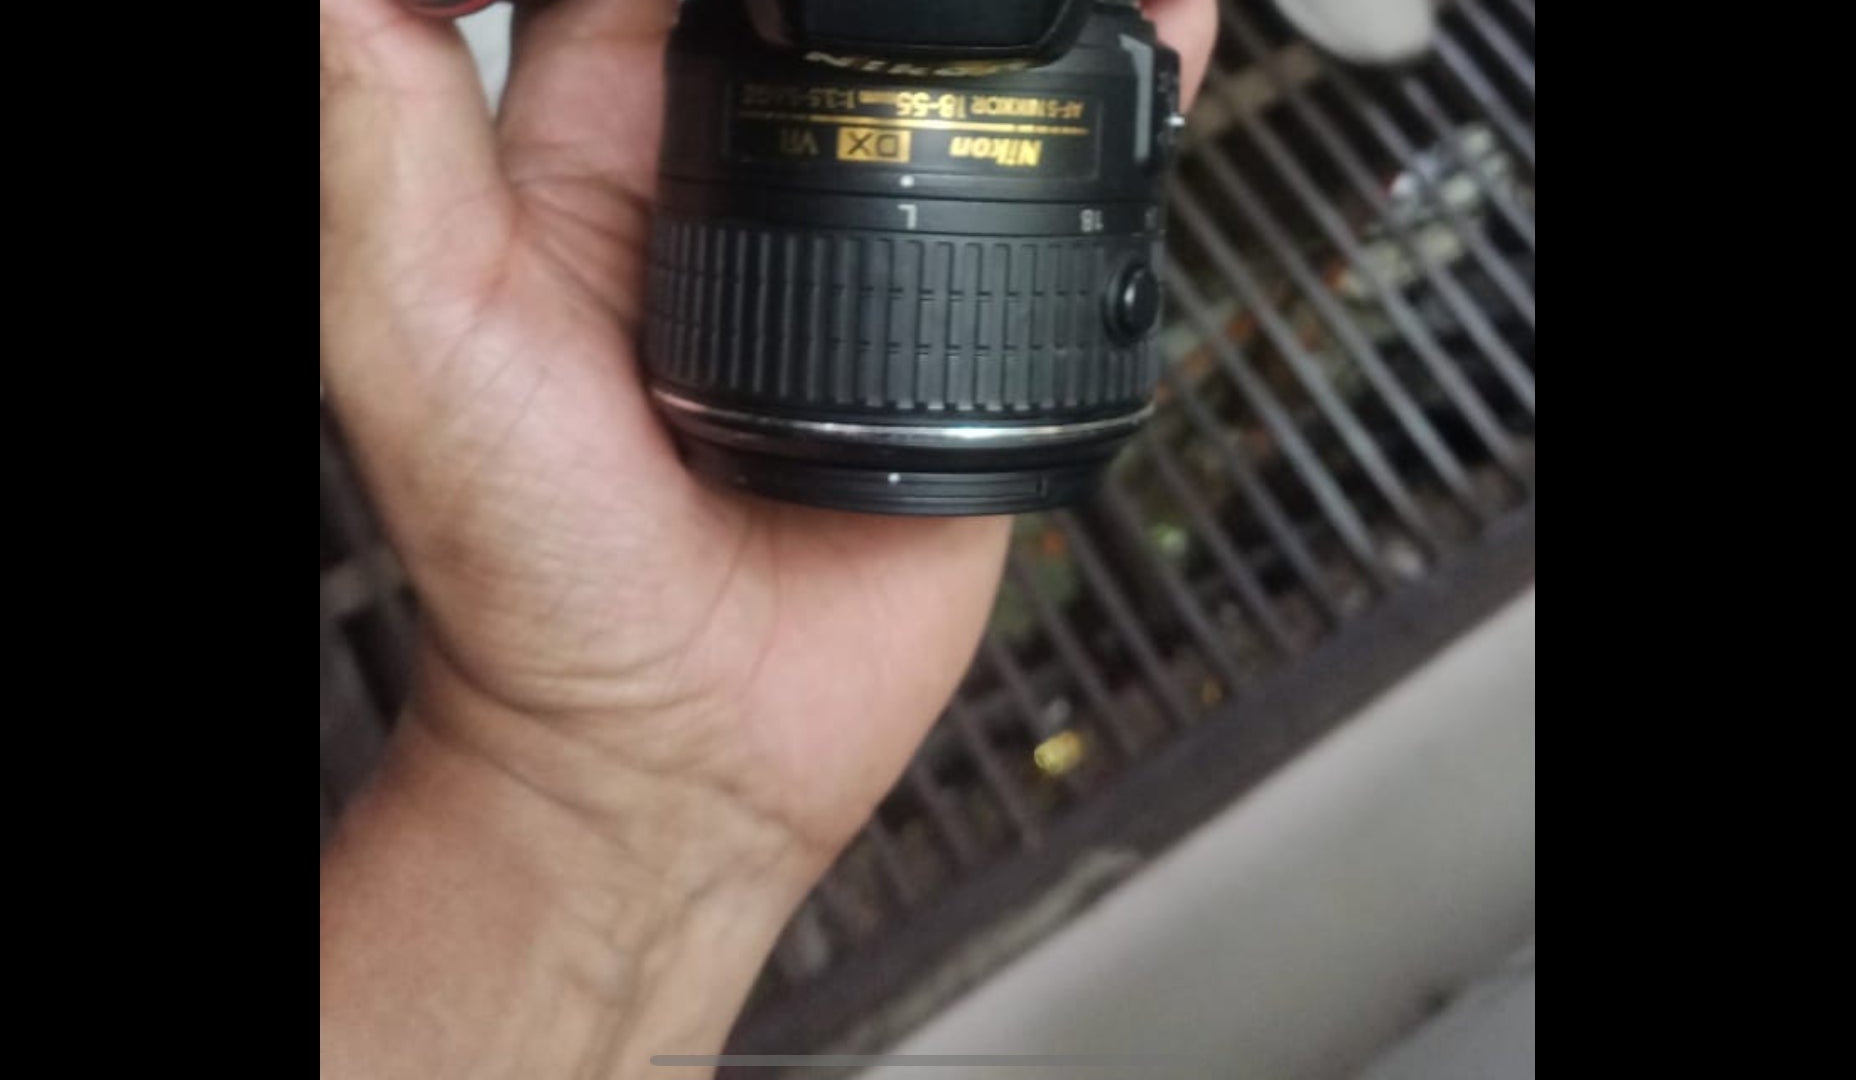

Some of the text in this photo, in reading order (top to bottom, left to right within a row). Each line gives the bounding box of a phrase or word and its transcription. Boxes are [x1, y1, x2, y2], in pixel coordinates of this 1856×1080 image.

[843, 129, 903, 159] DX
[949, 135, 1043, 167] Nikon
[897, 204, 917, 230] L
